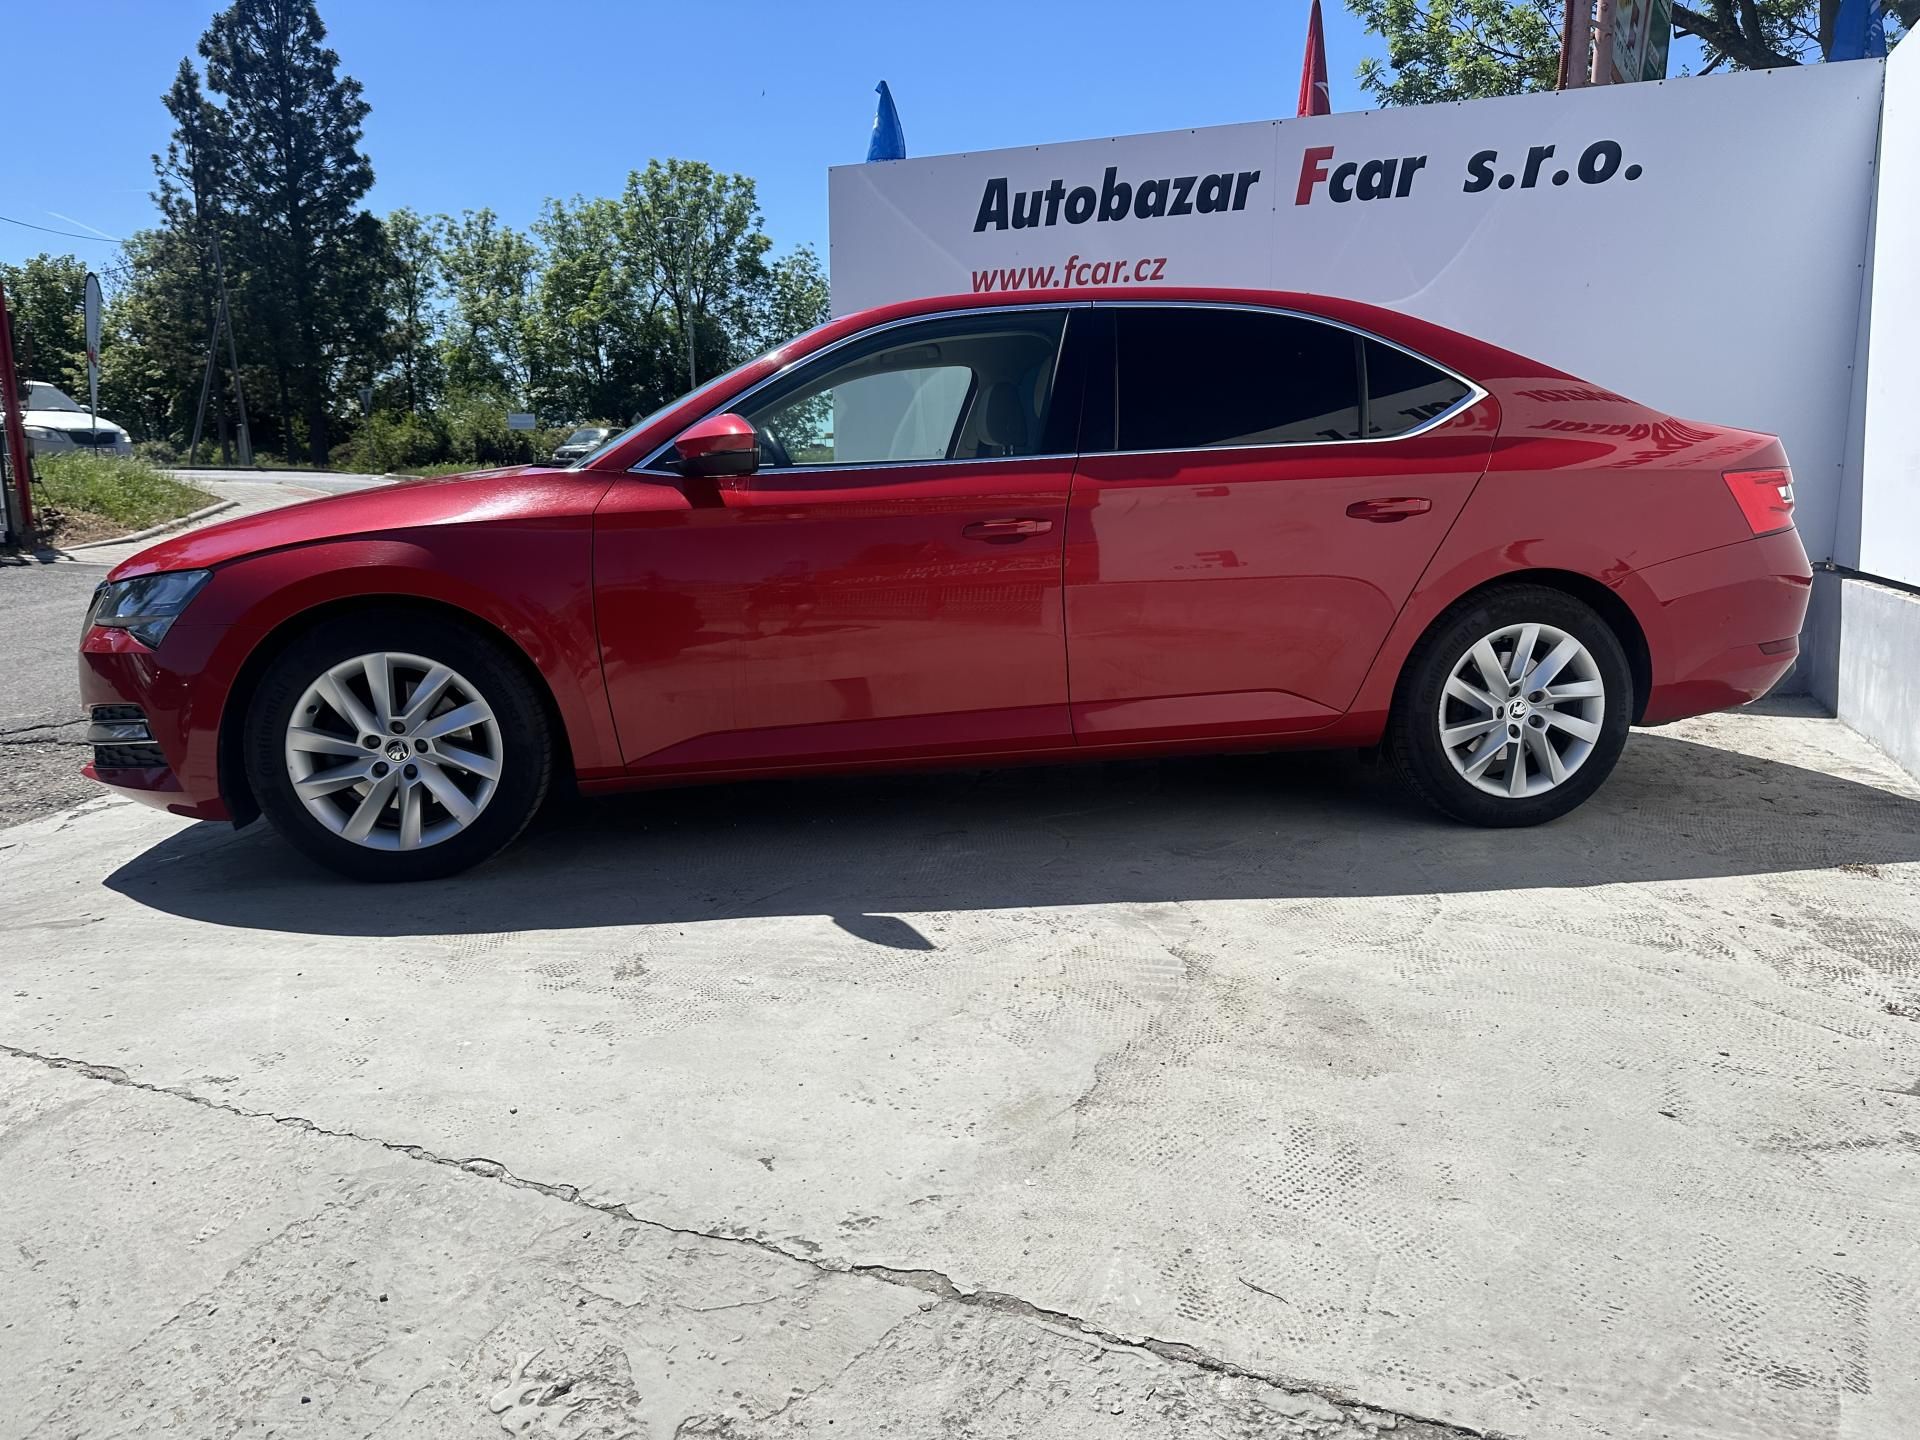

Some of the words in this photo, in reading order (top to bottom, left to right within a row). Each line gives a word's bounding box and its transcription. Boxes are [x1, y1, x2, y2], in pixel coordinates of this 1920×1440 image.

[973, 167, 1261, 232] Autobazar
[1295, 146, 1428, 206] Fcar
[1463, 140, 1643, 193] s.r.o.
[972, 255, 1168, 293] www.fcar.cz
